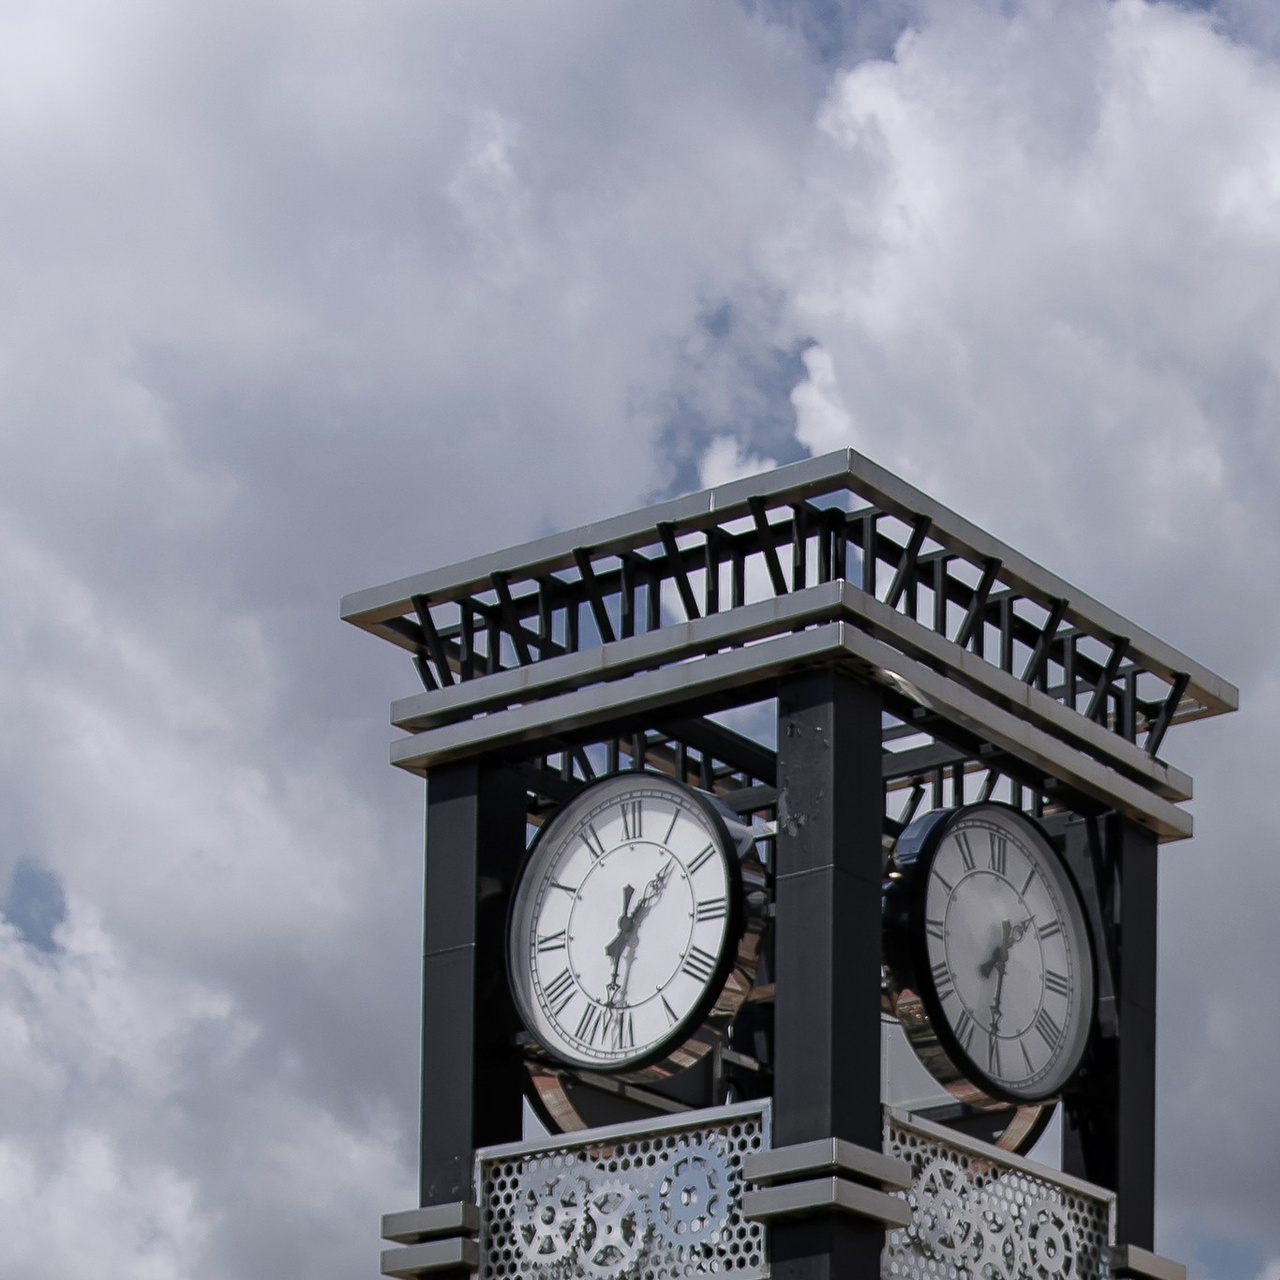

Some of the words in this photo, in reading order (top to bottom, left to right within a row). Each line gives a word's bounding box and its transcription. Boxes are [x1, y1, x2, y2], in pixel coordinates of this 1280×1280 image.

[620, 799, 643, 841] XII
[663, 806, 681, 845] I
[578, 823, 605, 864] XI
[686, 840, 717, 876] II
[955, 831, 977, 873] XI
[987, 832, 1007, 876] XII
[1020, 867, 1036, 897] I
[695, 896, 728, 923] III
[537, 928, 566, 954] IX
[1038, 919, 1061, 940] II
[681, 944, 717, 984] IIII
[1045, 968, 1068, 998] III
[542, 967, 579, 1018] VIII
[660, 993, 679, 1028] V
[573, 1002, 603, 1047] VII
[1034, 1007, 1061, 1052] IIII
[1019, 1039, 1035, 1077] V
